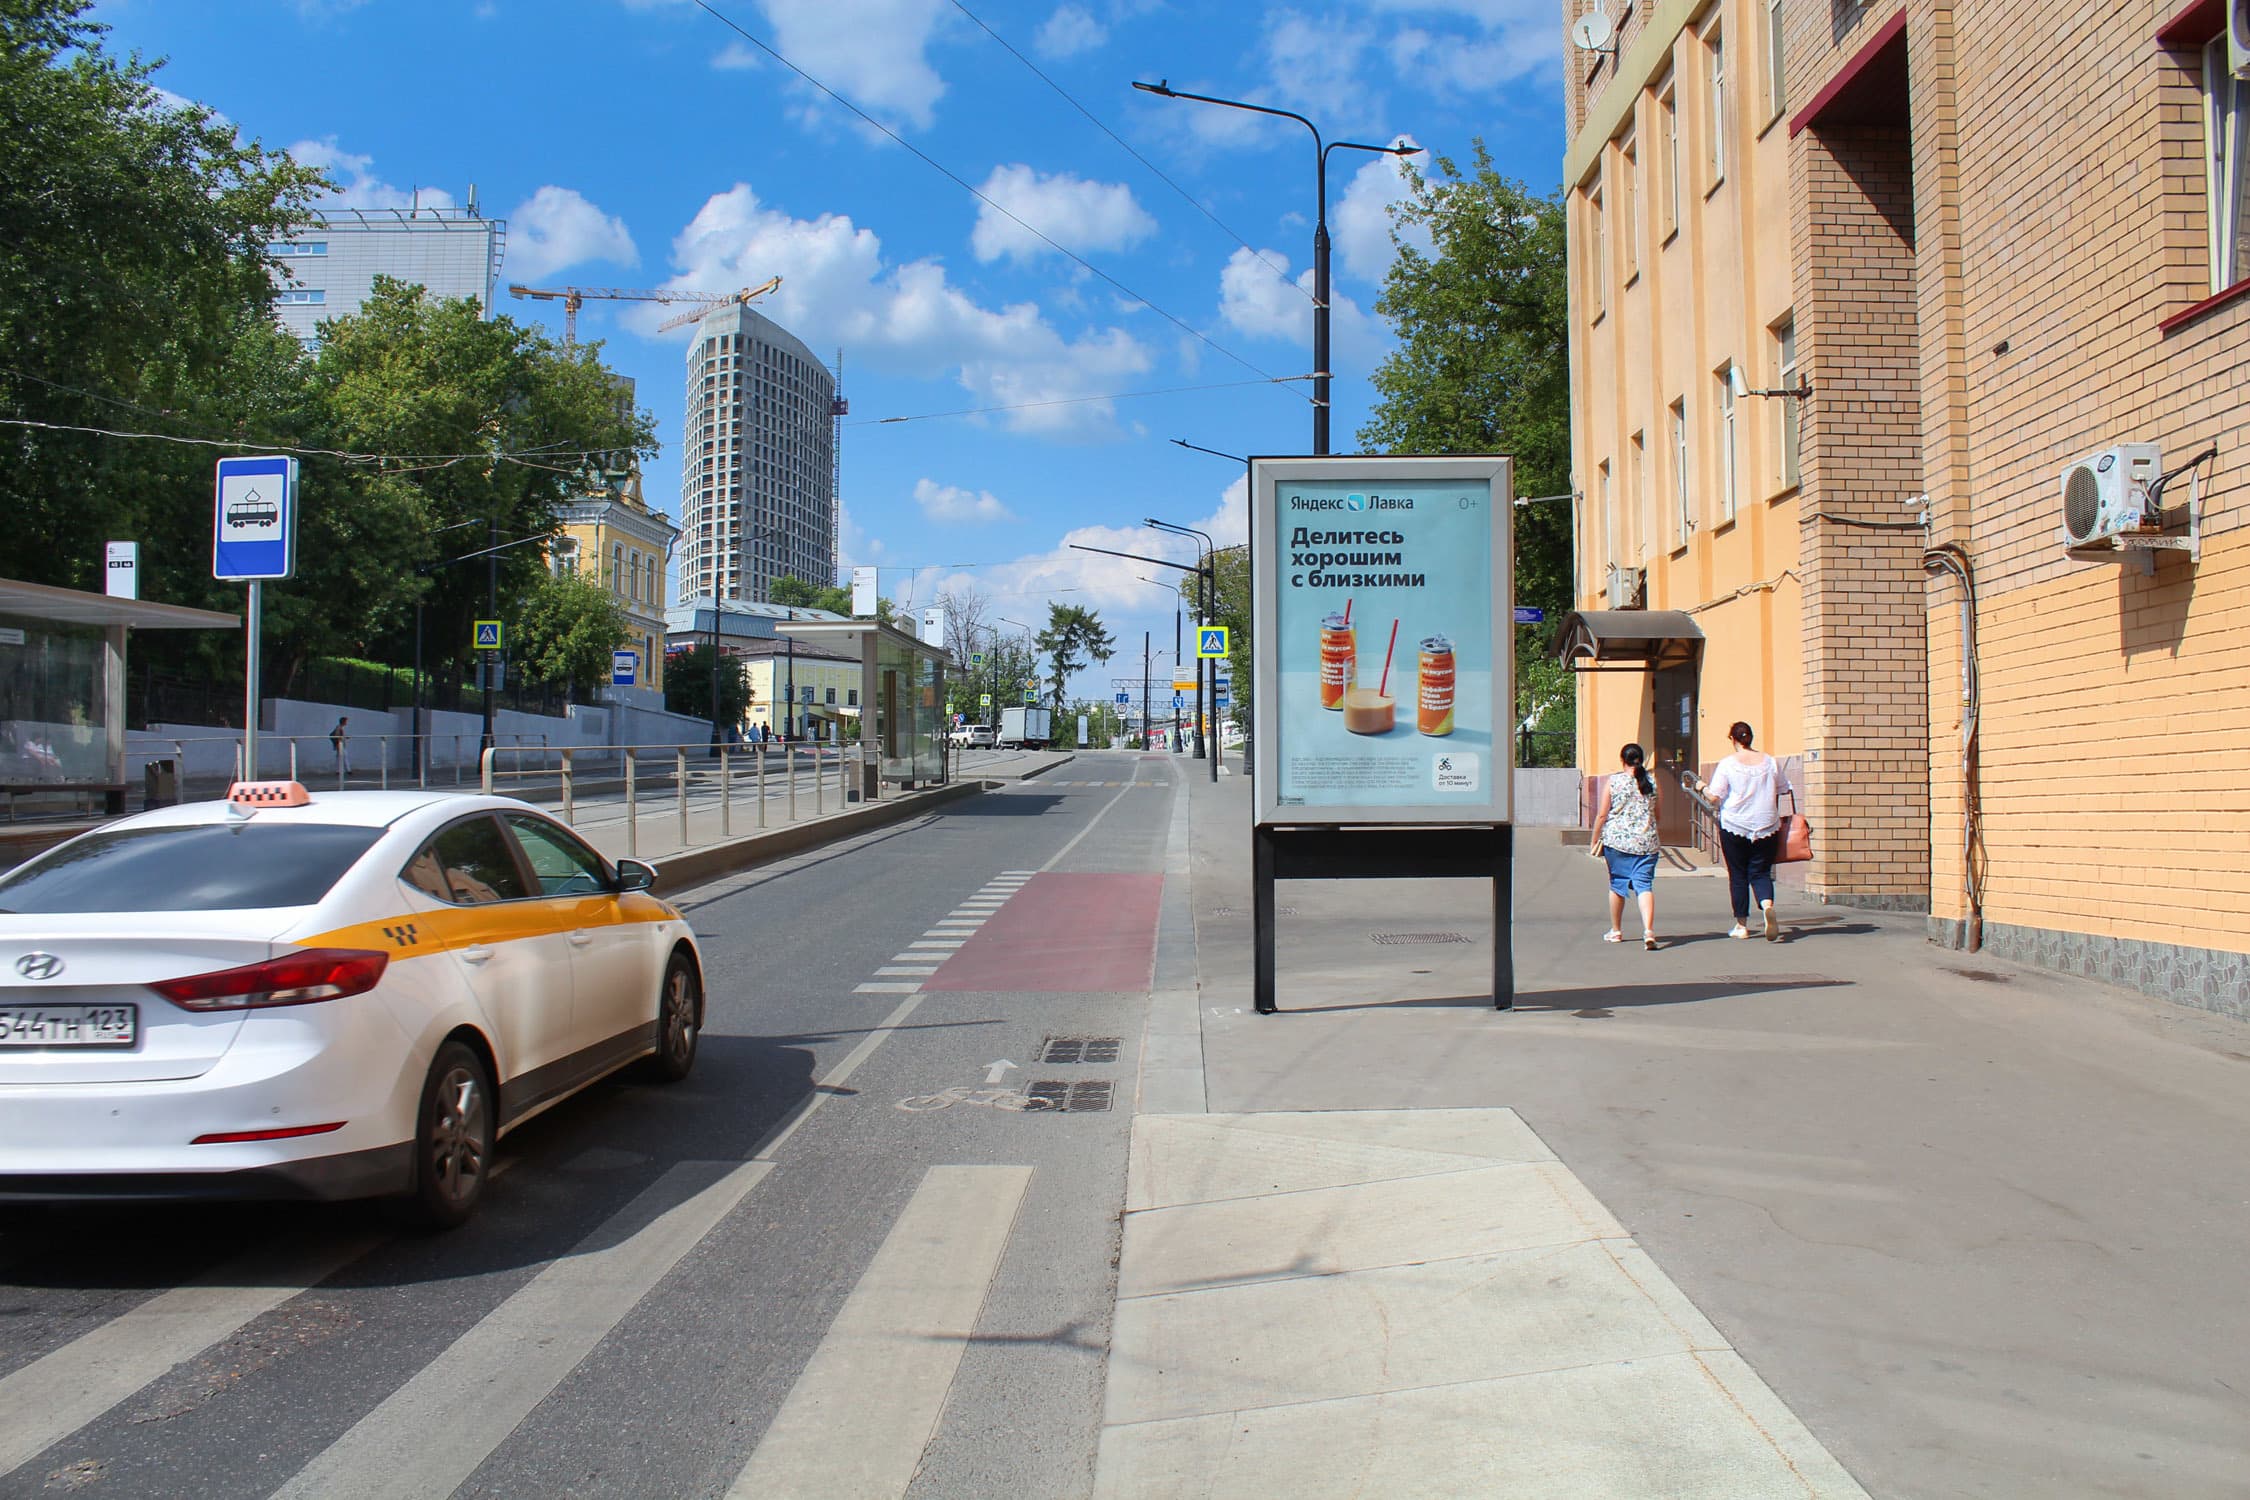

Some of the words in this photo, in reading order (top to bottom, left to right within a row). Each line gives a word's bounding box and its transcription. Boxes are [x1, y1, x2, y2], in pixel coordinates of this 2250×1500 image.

[1291, 496, 1344, 512] Яндекс
[1369, 496, 1414, 510] Лавка
[1458, 497, 1478, 510] 0+
[1291, 527, 1404, 548] Делитесь
[1291, 552, 1401, 570] хорошим
[1291, 574, 1303, 587] с
[1308, 569, 1425, 587] близкими
[87, 1008, 129, 1031] 123
